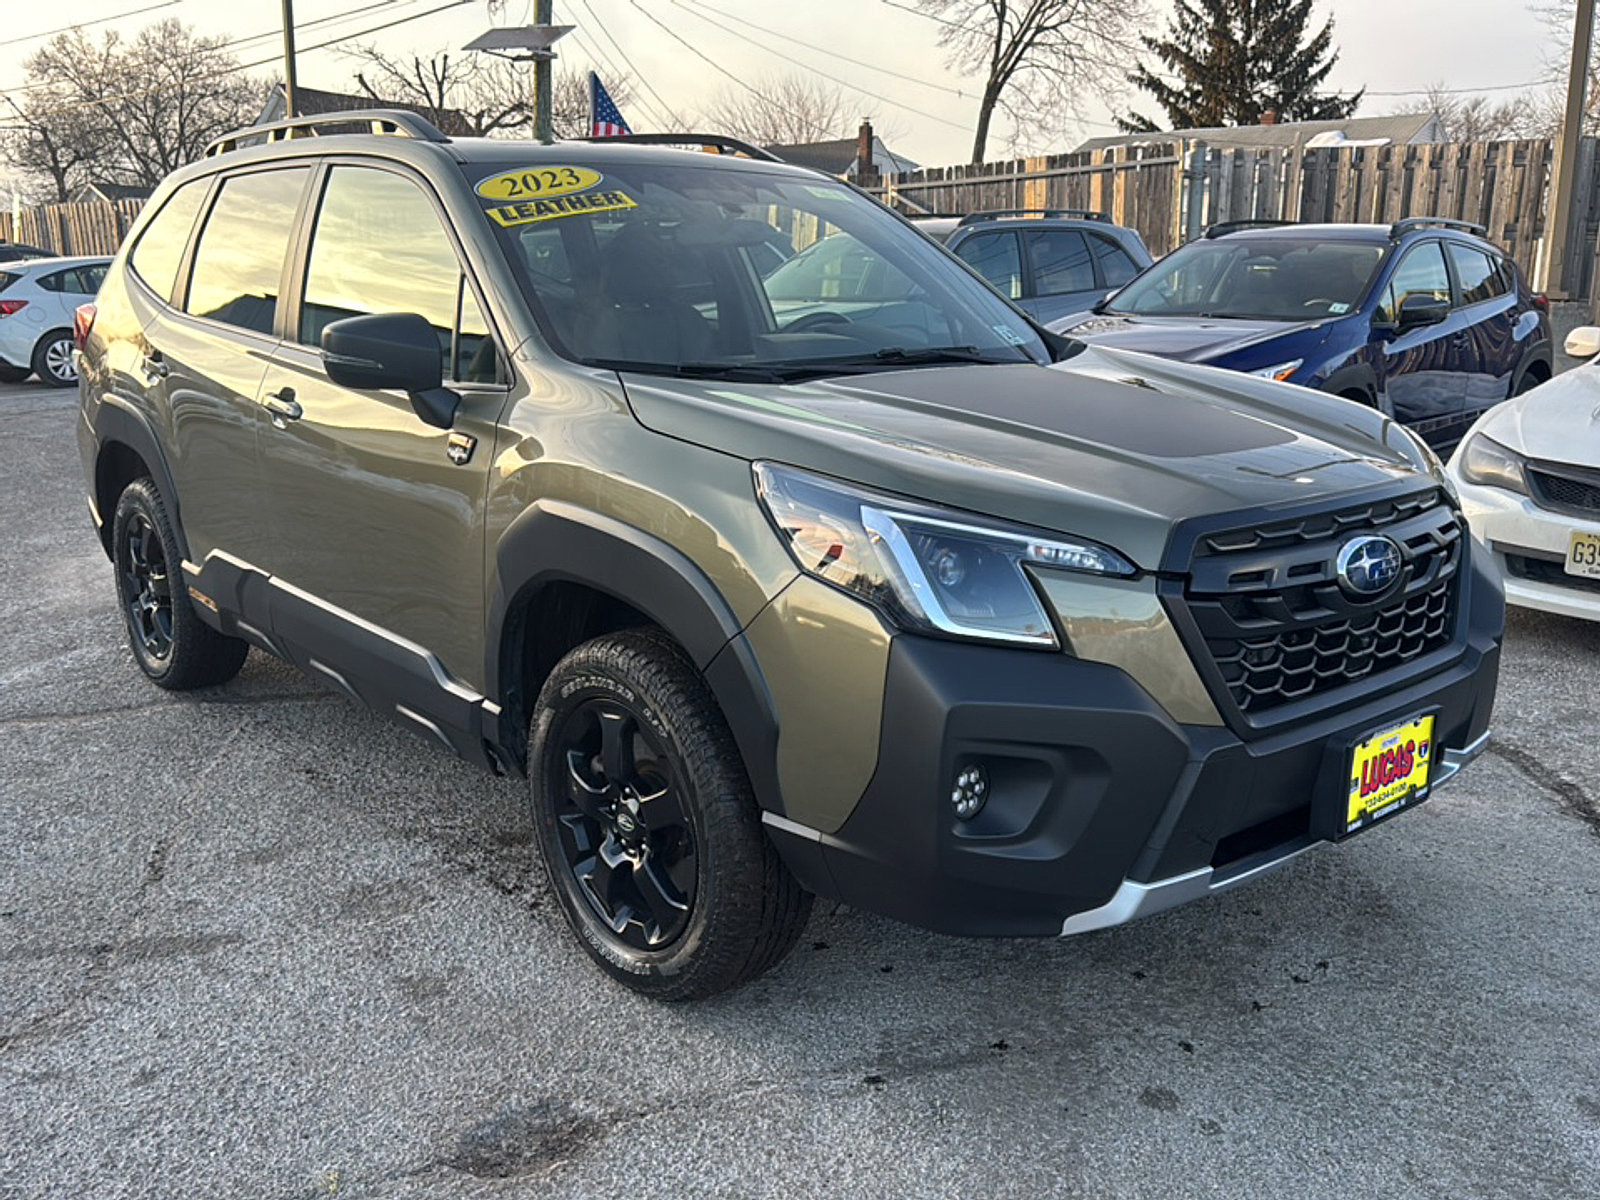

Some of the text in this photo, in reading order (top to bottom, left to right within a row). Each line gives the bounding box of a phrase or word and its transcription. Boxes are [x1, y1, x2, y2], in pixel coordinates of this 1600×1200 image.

[500, 168, 581, 197] 2023
[497, 192, 627, 221] LEATHER
[1573, 541, 1600, 566] G3
[1360, 739, 1415, 798] LUCAS
